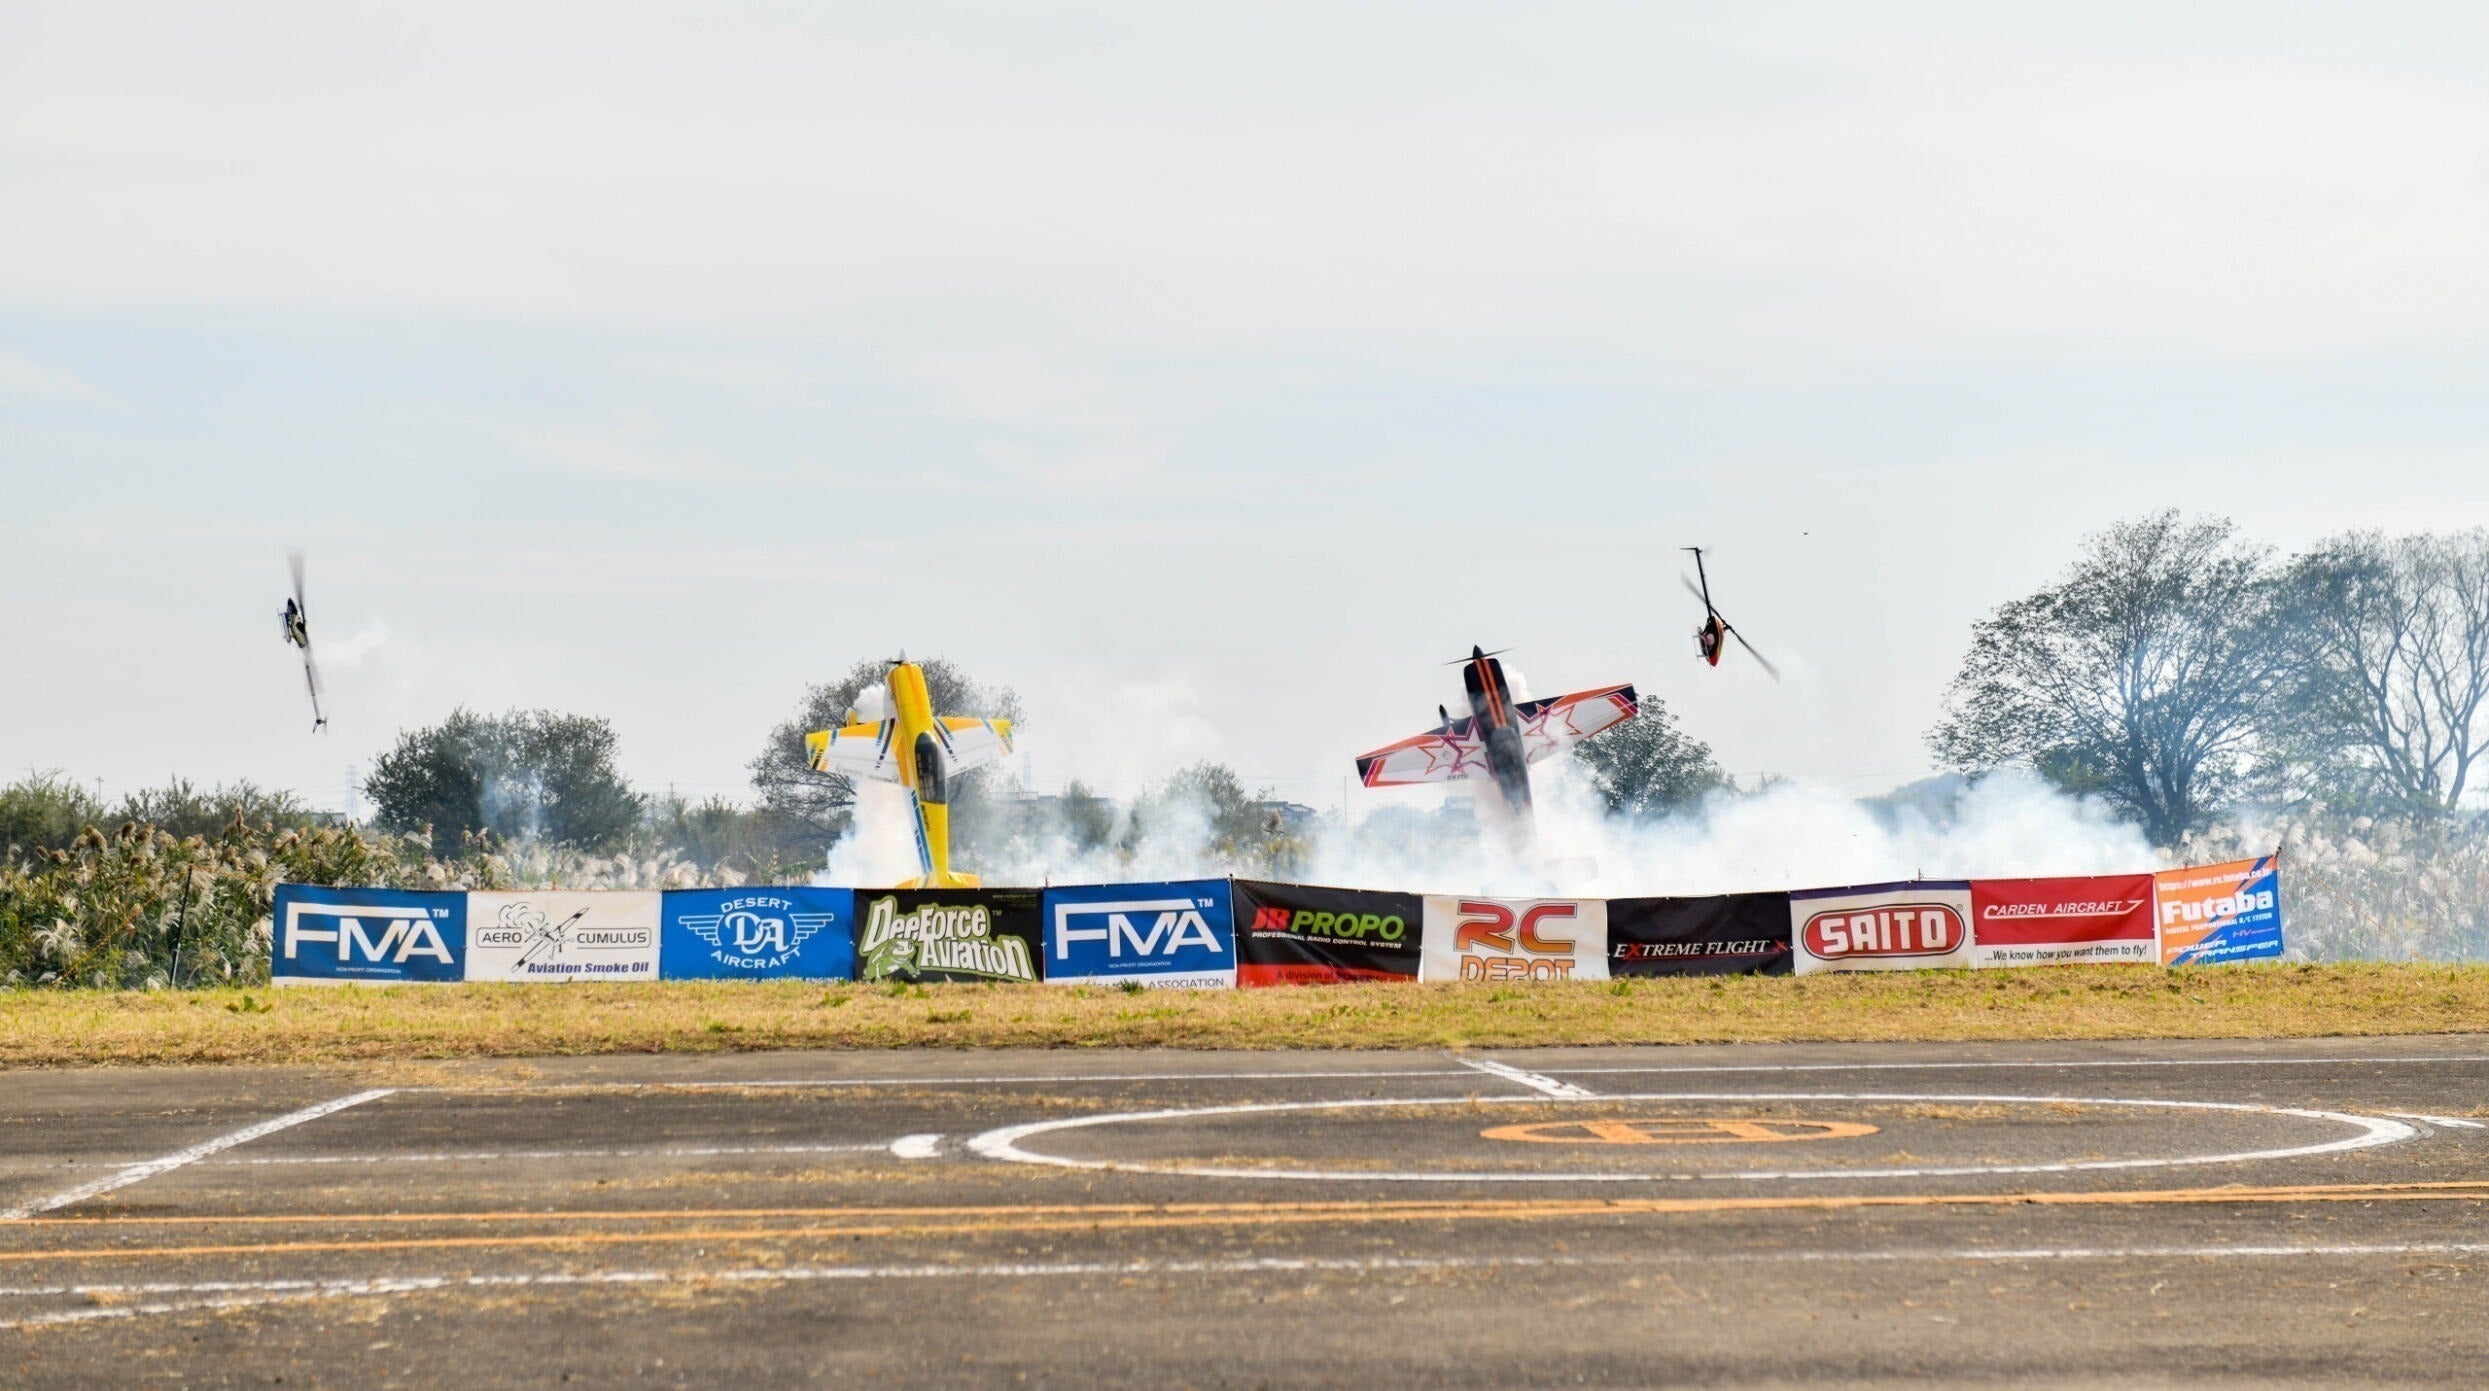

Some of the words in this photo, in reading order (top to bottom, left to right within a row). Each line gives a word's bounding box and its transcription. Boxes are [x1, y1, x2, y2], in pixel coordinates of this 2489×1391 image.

[720, 897, 793, 914] DESERT
[1984, 903, 2048, 919] CARDEN
[2053, 900, 2123, 914] AIRCRAFT
[2161, 890, 2274, 925] Futaba
[1251, 906, 1291, 931] JR
[1291, 910, 1405, 941] PROPO
[2239, 914, 2252, 924] R/C
[2252, 912, 2273, 921] SYSTEM
[284, 902, 455, 964] FMA
[1055, 898, 1223, 960] FMA
[1453, 900, 1578, 956] RC
[1819, 910, 1948, 954] SAITO
[482, 932, 522, 943] AERO
[576, 932, 648, 944] CUMULUS
[1252, 931, 1306, 942] PROFESSIONAL
[1307, 935, 1331, 944] RADIO
[1332, 938, 1368, 947] CONTROL
[1370, 941, 1402, 949] SYSTEM
[2166, 939, 2228, 955] POWER
[710, 945, 801, 969] AIRCRAFT
[919, 934, 1034, 981] Aviation
[1613, 942, 1703, 959] EXTREME
[1704, 940, 1770, 955] FLIGHT
[2009, 949, 2034, 960] know
[2036, 949, 2054, 960] how
[2055, 949, 2072, 961] you
[2073, 946, 2093, 957] want
[2095, 945, 2119, 956] them
[2121, 945, 2131, 955] to
[2132, 944, 2148, 956] fly!
[2189, 940, 2279, 958] TRANSFER
[527, 962, 582, 974] Aviation
[584, 962, 629, 973] Smoke
[631, 961, 649, 973] Oil
[1285, 970, 1323, 979] division
[1460, 955, 1576, 982] DEPOT
[1149, 977, 1224, 989] ASSOCIATION
